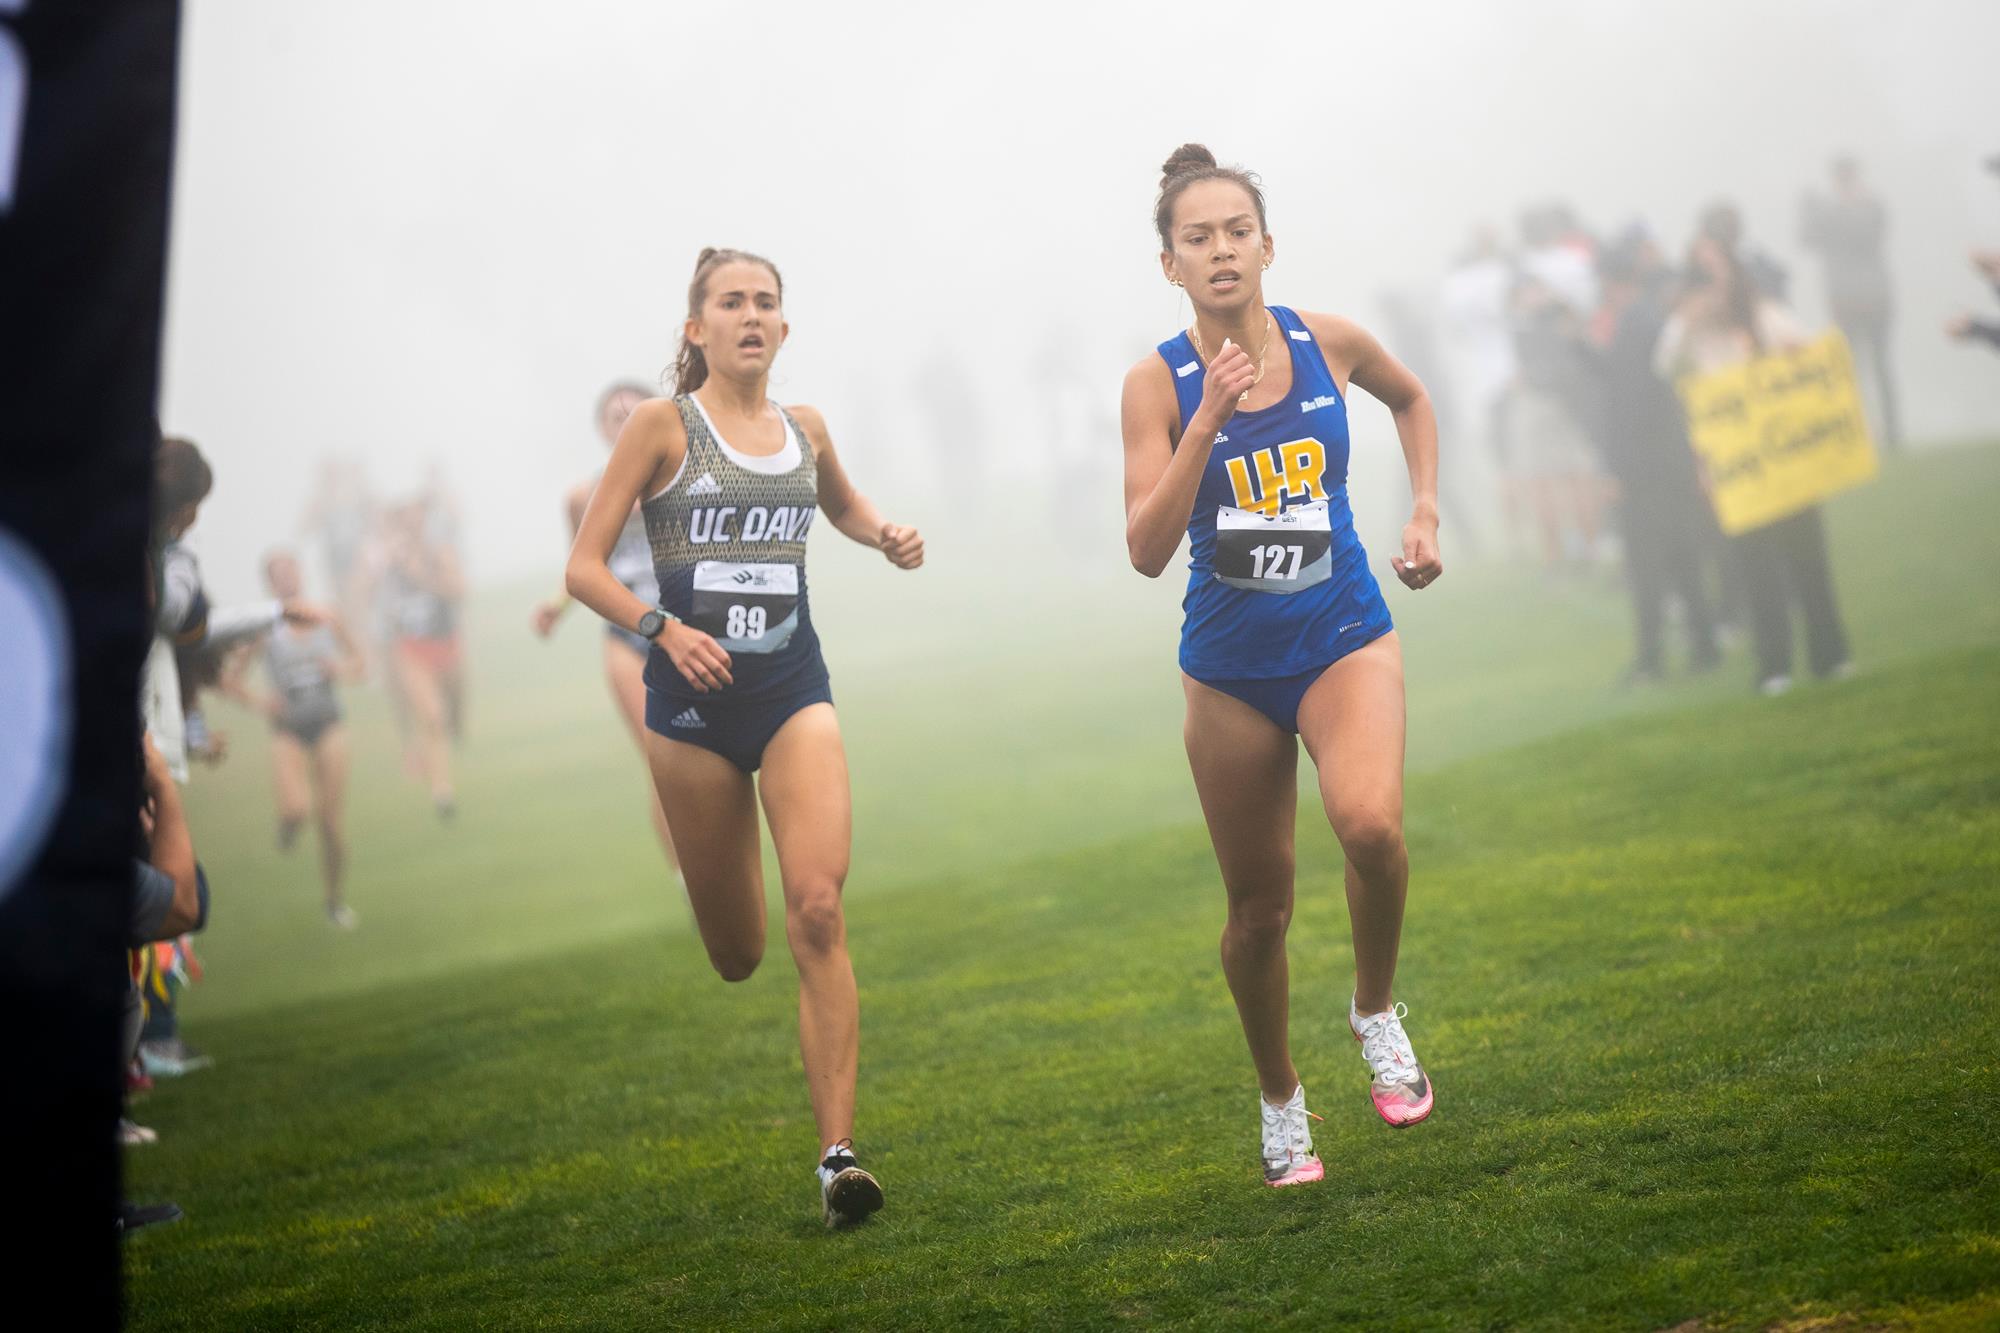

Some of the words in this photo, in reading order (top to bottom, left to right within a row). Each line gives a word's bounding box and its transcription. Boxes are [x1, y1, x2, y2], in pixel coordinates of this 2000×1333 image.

[689, 506, 738, 544] UC
[740, 505, 818, 543] DAVI
[1249, 544, 1304, 580] 127
[726, 604, 767, 640] 89
